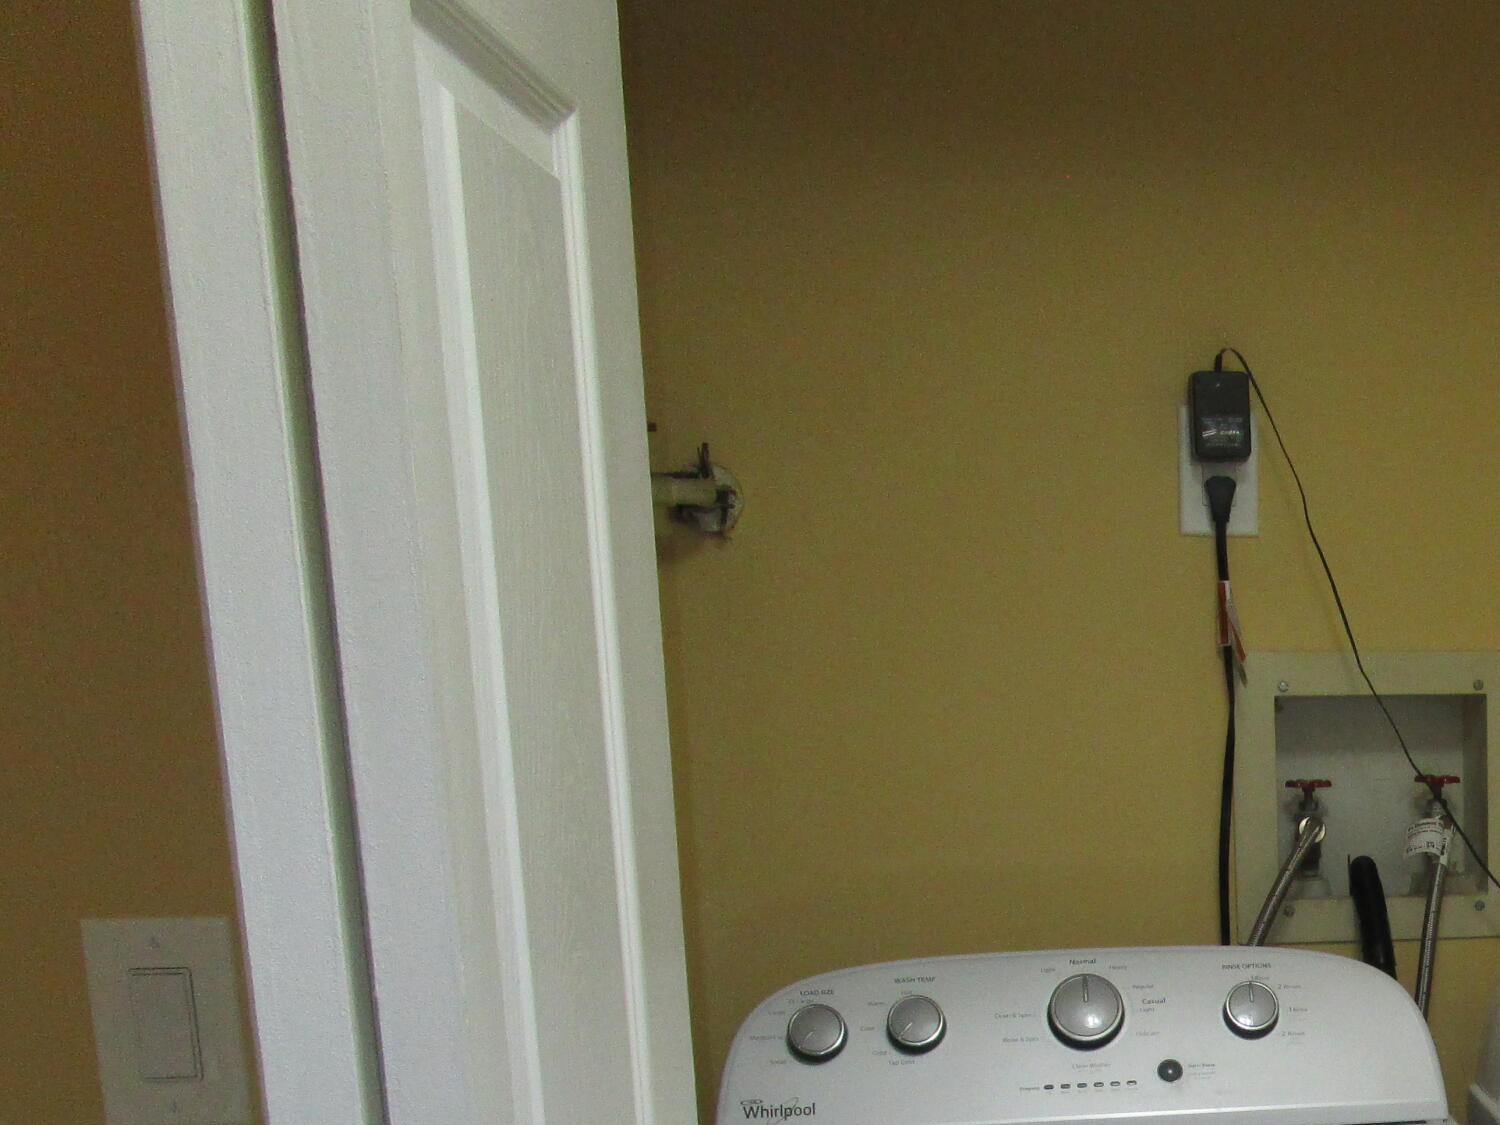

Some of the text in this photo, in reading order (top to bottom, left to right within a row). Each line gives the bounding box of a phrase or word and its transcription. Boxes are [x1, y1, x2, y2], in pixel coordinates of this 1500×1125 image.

[1069, 958, 1096, 966] Normal
[1142, 997, 1166, 1005] Casual
[743, 1102, 816, 1121] Whirlpool
